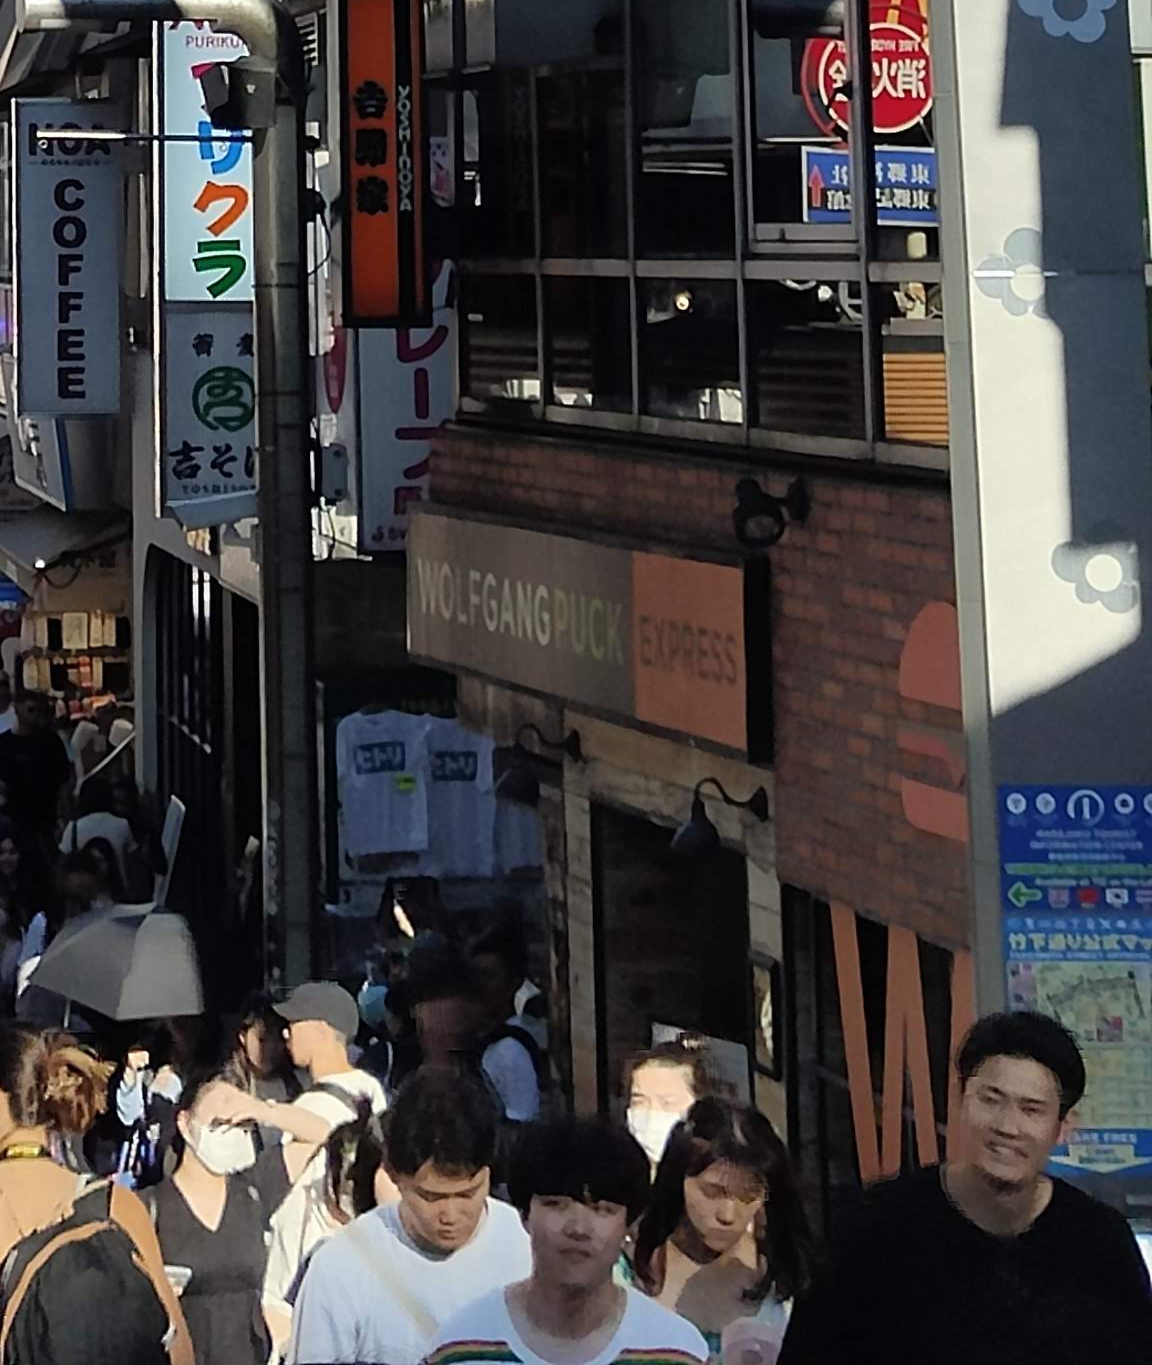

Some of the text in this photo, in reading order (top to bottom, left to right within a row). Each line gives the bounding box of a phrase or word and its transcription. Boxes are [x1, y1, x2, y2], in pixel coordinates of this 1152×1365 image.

[185, 34, 248, 49] PURIKU
[191, 61, 250, 300] リクラ
[398, 84, 412, 212] YOSHINOYA
[51, 178, 88, 401] COFFEE
[416, 557, 738, 690] WOLFGANG PUCK EXPRESS
